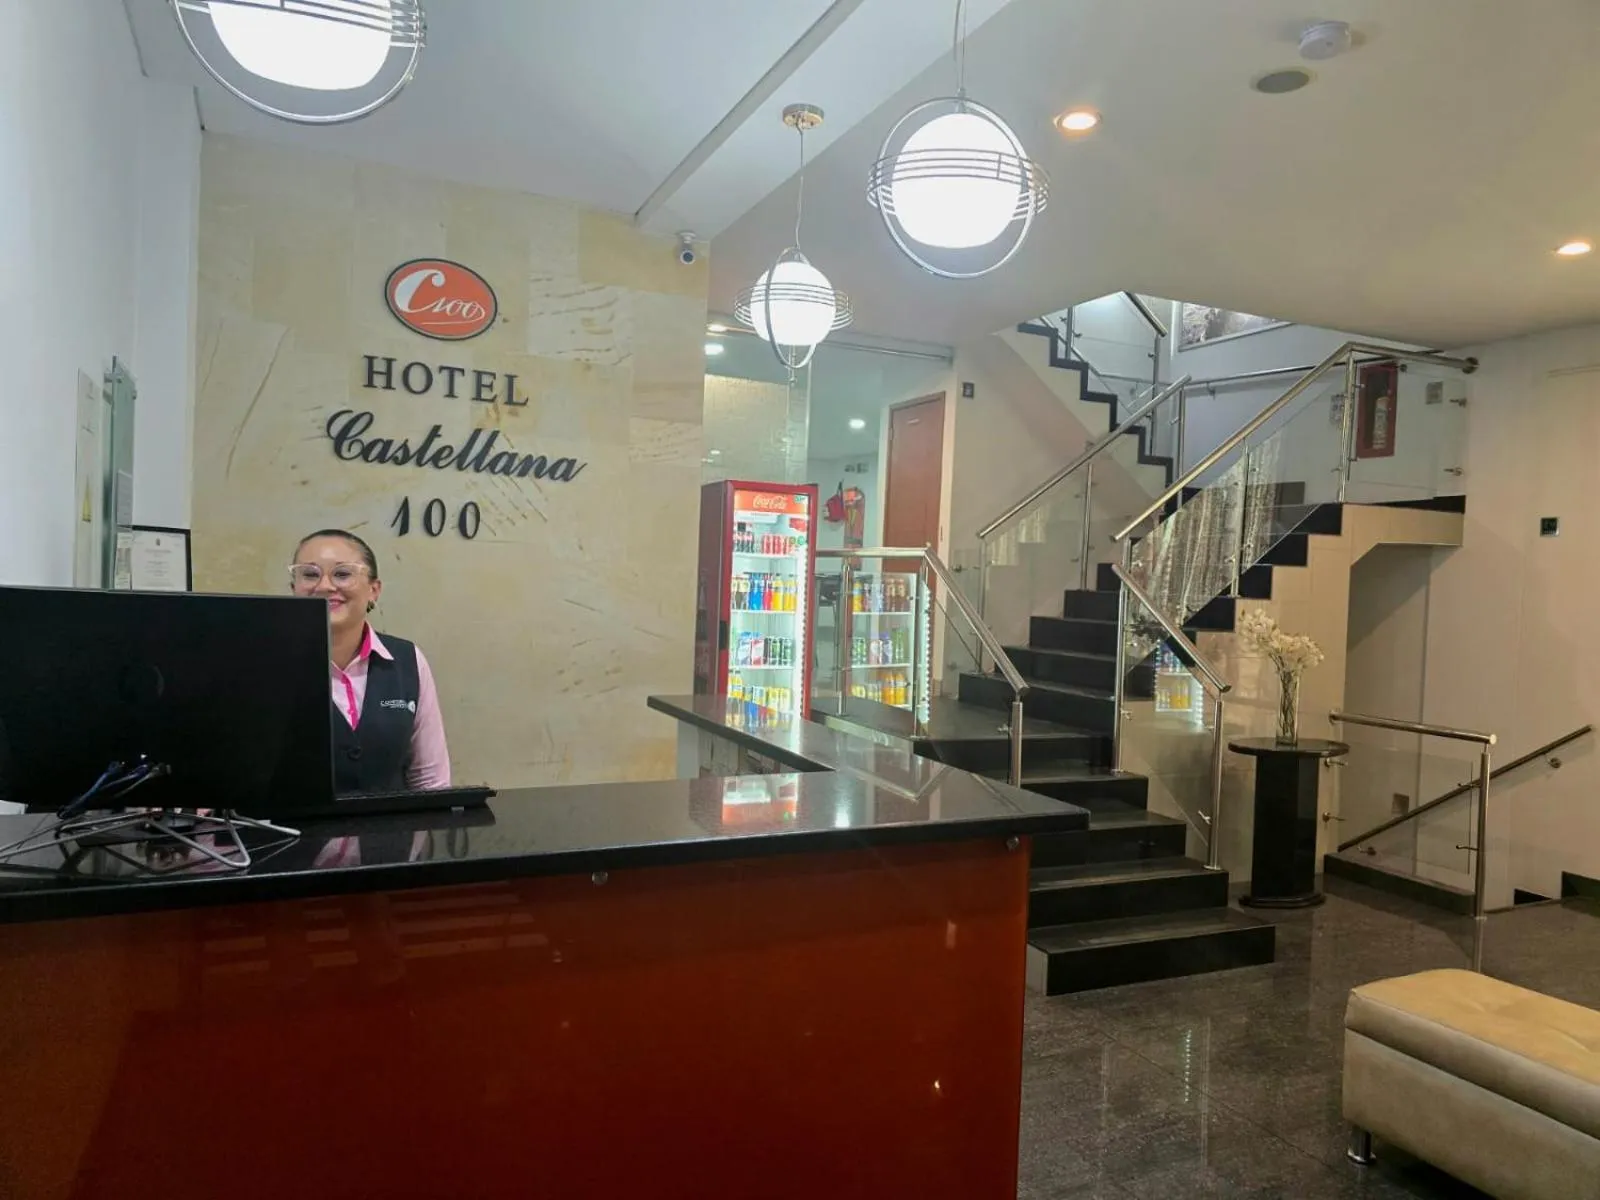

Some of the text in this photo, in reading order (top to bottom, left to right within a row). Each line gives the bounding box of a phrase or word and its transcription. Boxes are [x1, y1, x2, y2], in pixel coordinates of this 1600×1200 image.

[362, 354, 529, 407] HOTEL
[326, 409, 588, 483] Castellana
[390, 495, 481, 540] 100
